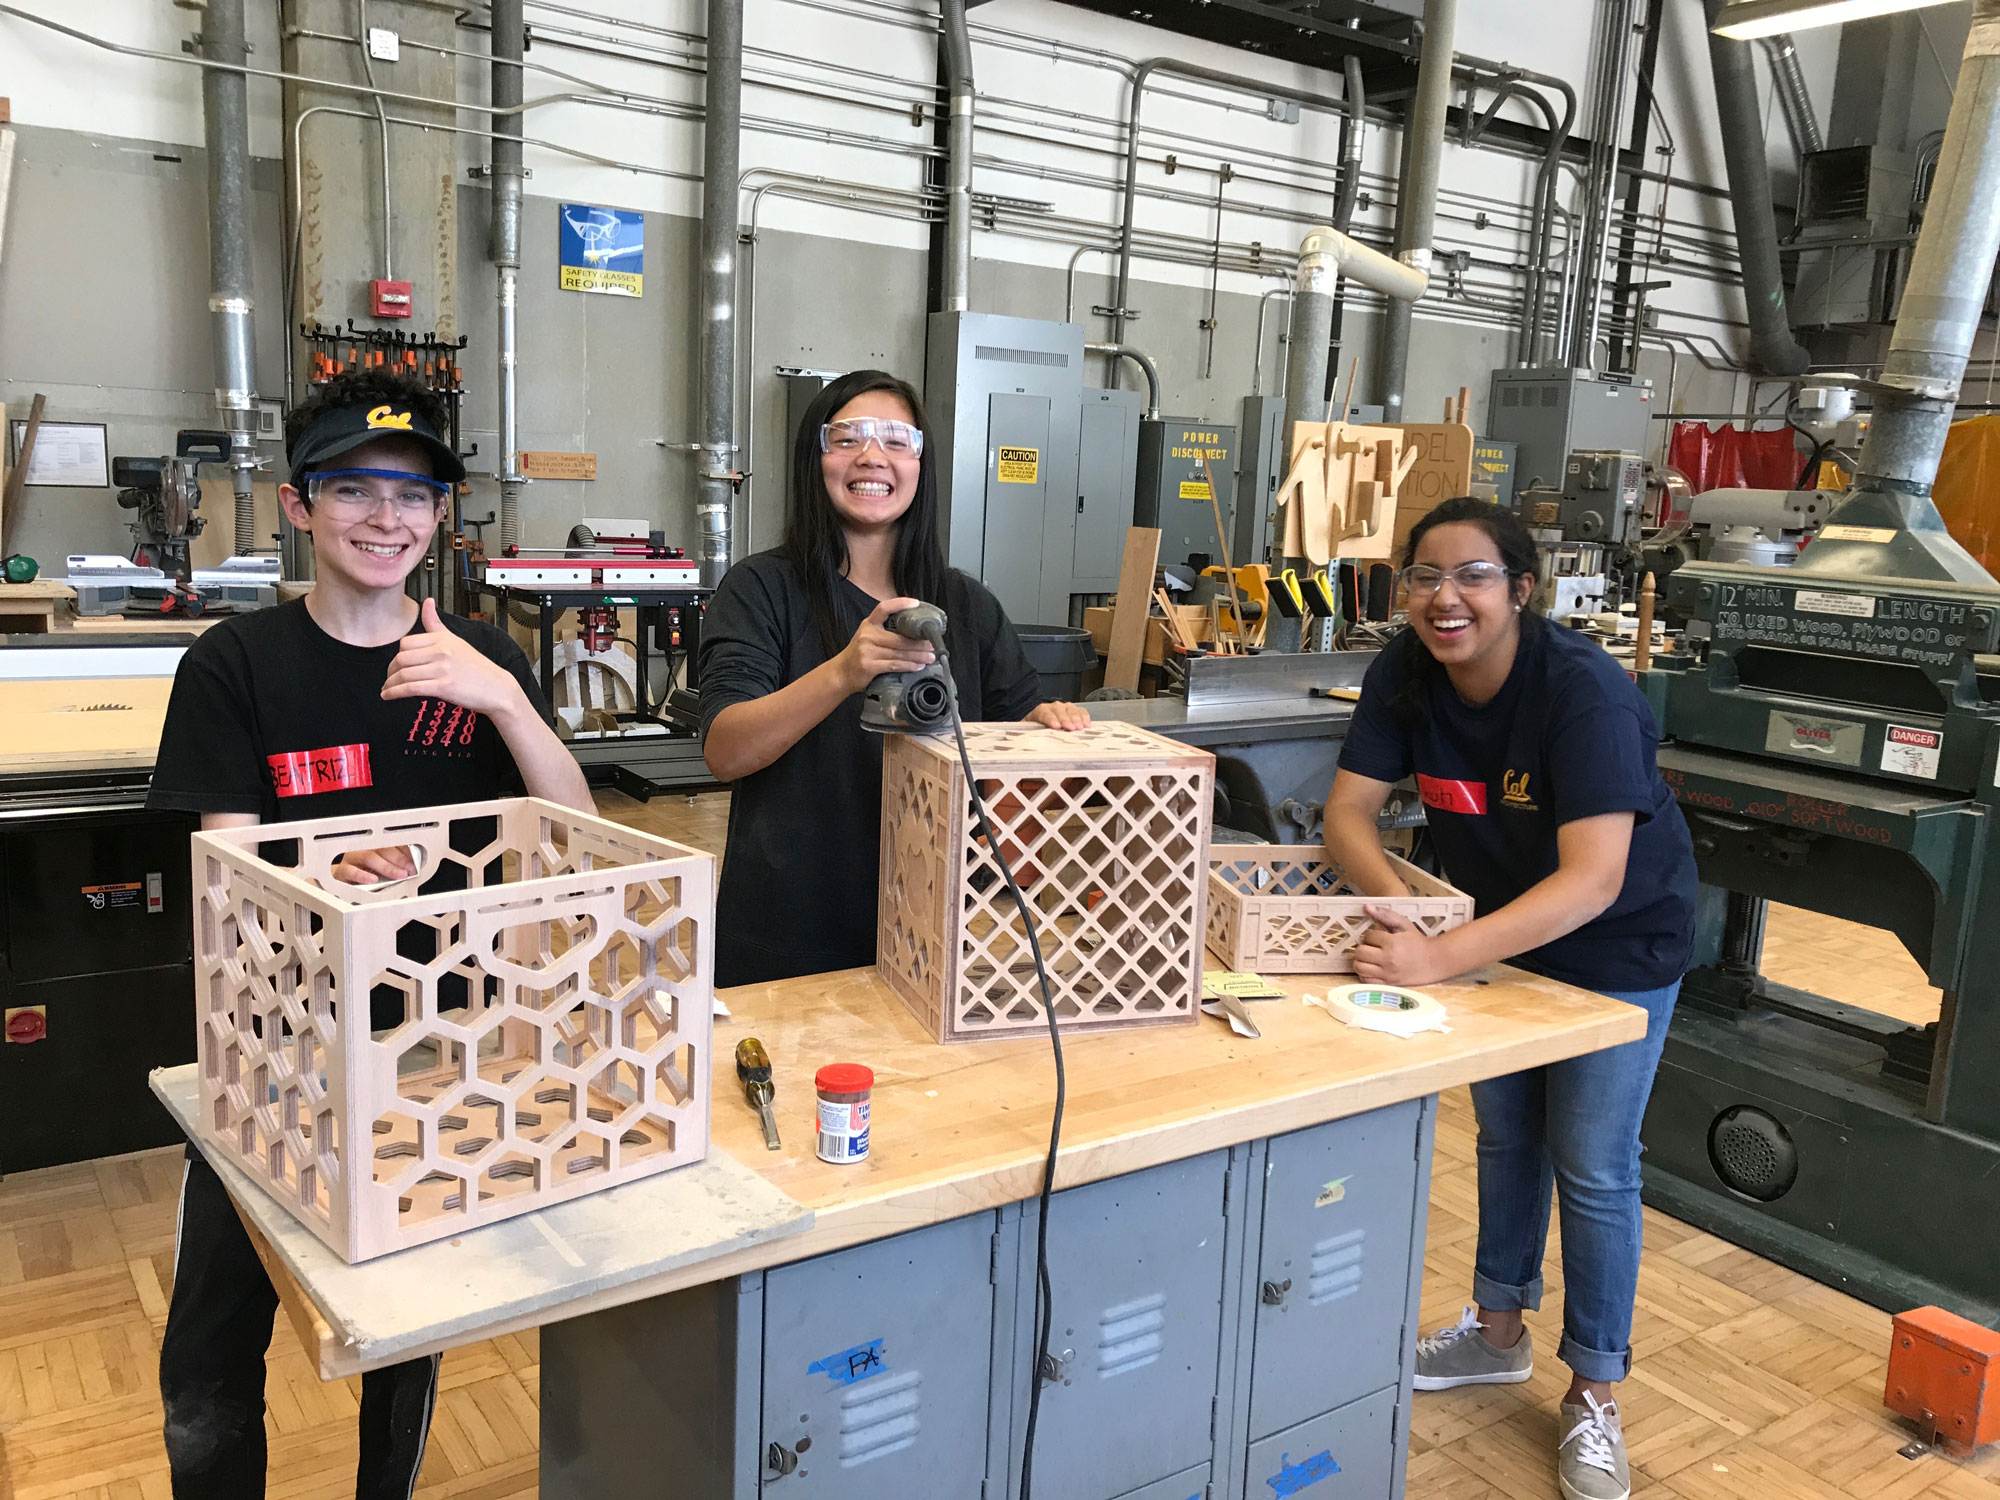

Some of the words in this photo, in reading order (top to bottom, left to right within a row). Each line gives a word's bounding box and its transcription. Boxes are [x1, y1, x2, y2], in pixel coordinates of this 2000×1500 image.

[565, 268, 597, 278] SAFETY
[600, 272, 636, 283] GLASSES
[366, 404, 413, 430] Cal
[1183, 431, 1219, 444] POWER
[1002, 450, 1036, 461] CAUTION
[1475, 448, 1504, 460] POWER
[1745, 588, 1784, 606] MIN.
[1716, 611, 1743, 628] NO
[1745, 613, 1788, 631] USED
[1878, 600, 1966, 624] LENGTH
[1818, 636, 1853, 651] MAN
[1856, 640, 1898, 657] MADE
[1901, 646, 1956, 667] STUFF!
[1796, 727, 1832, 740] OLIVER
[1892, 730, 1935, 745] DANGER
[1502, 768, 1532, 803] Cal
[1686, 791, 1735, 809] WOOD
